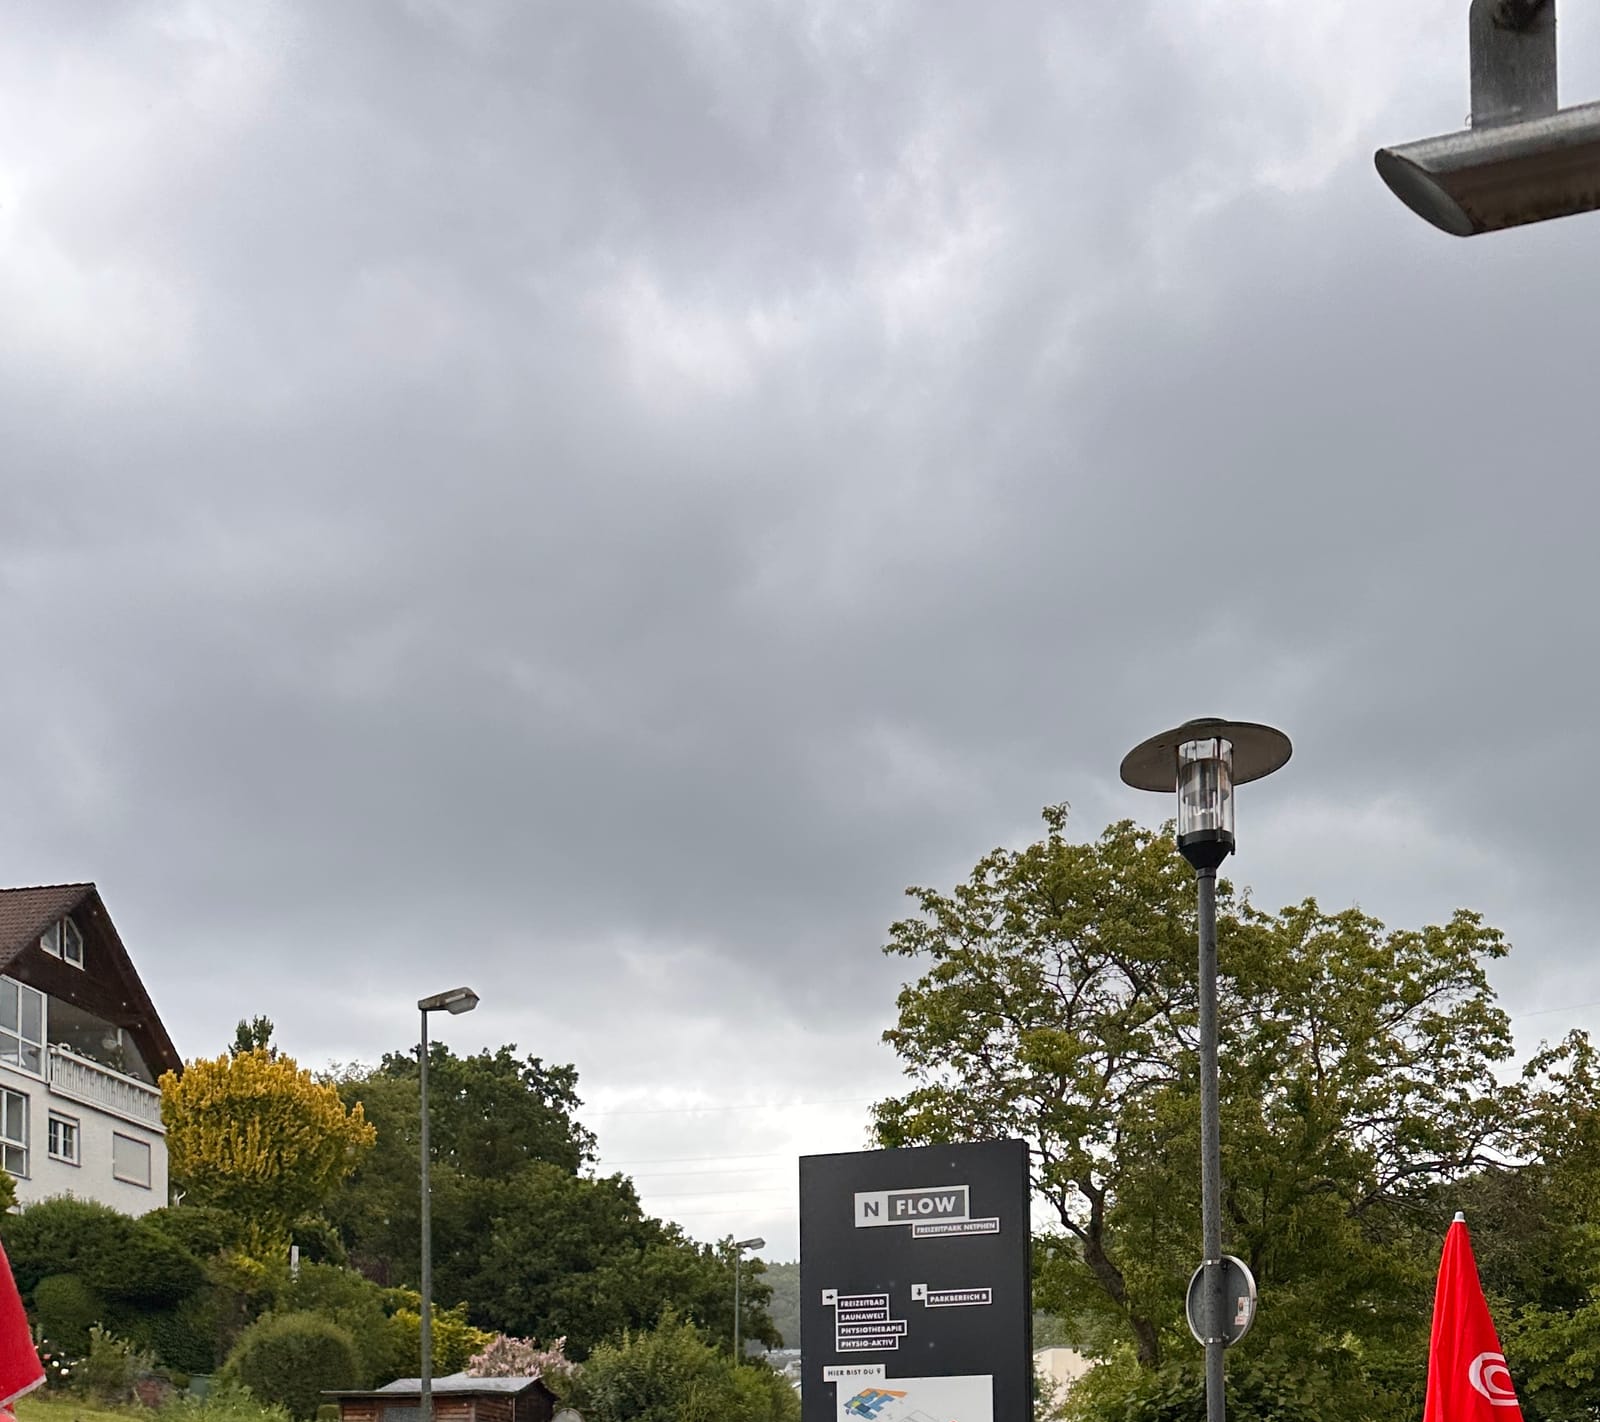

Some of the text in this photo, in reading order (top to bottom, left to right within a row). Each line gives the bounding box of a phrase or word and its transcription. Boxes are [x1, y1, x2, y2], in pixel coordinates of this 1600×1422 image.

[864, 1196, 956, 1217] N FLOW
[916, 1221, 996, 1234] FREIZEITPARK NETPHEN
[840, 1298, 885, 1308] FREIZEITBAD
[929, 1293, 980, 1303] PARKBEREICH
[841, 1312, 885, 1321] SAUNAWELT
[841, 1325, 903, 1335] PHYSIOTHERAPIE
[841, 1339, 894, 1348] PHYSIO-AKTIV
